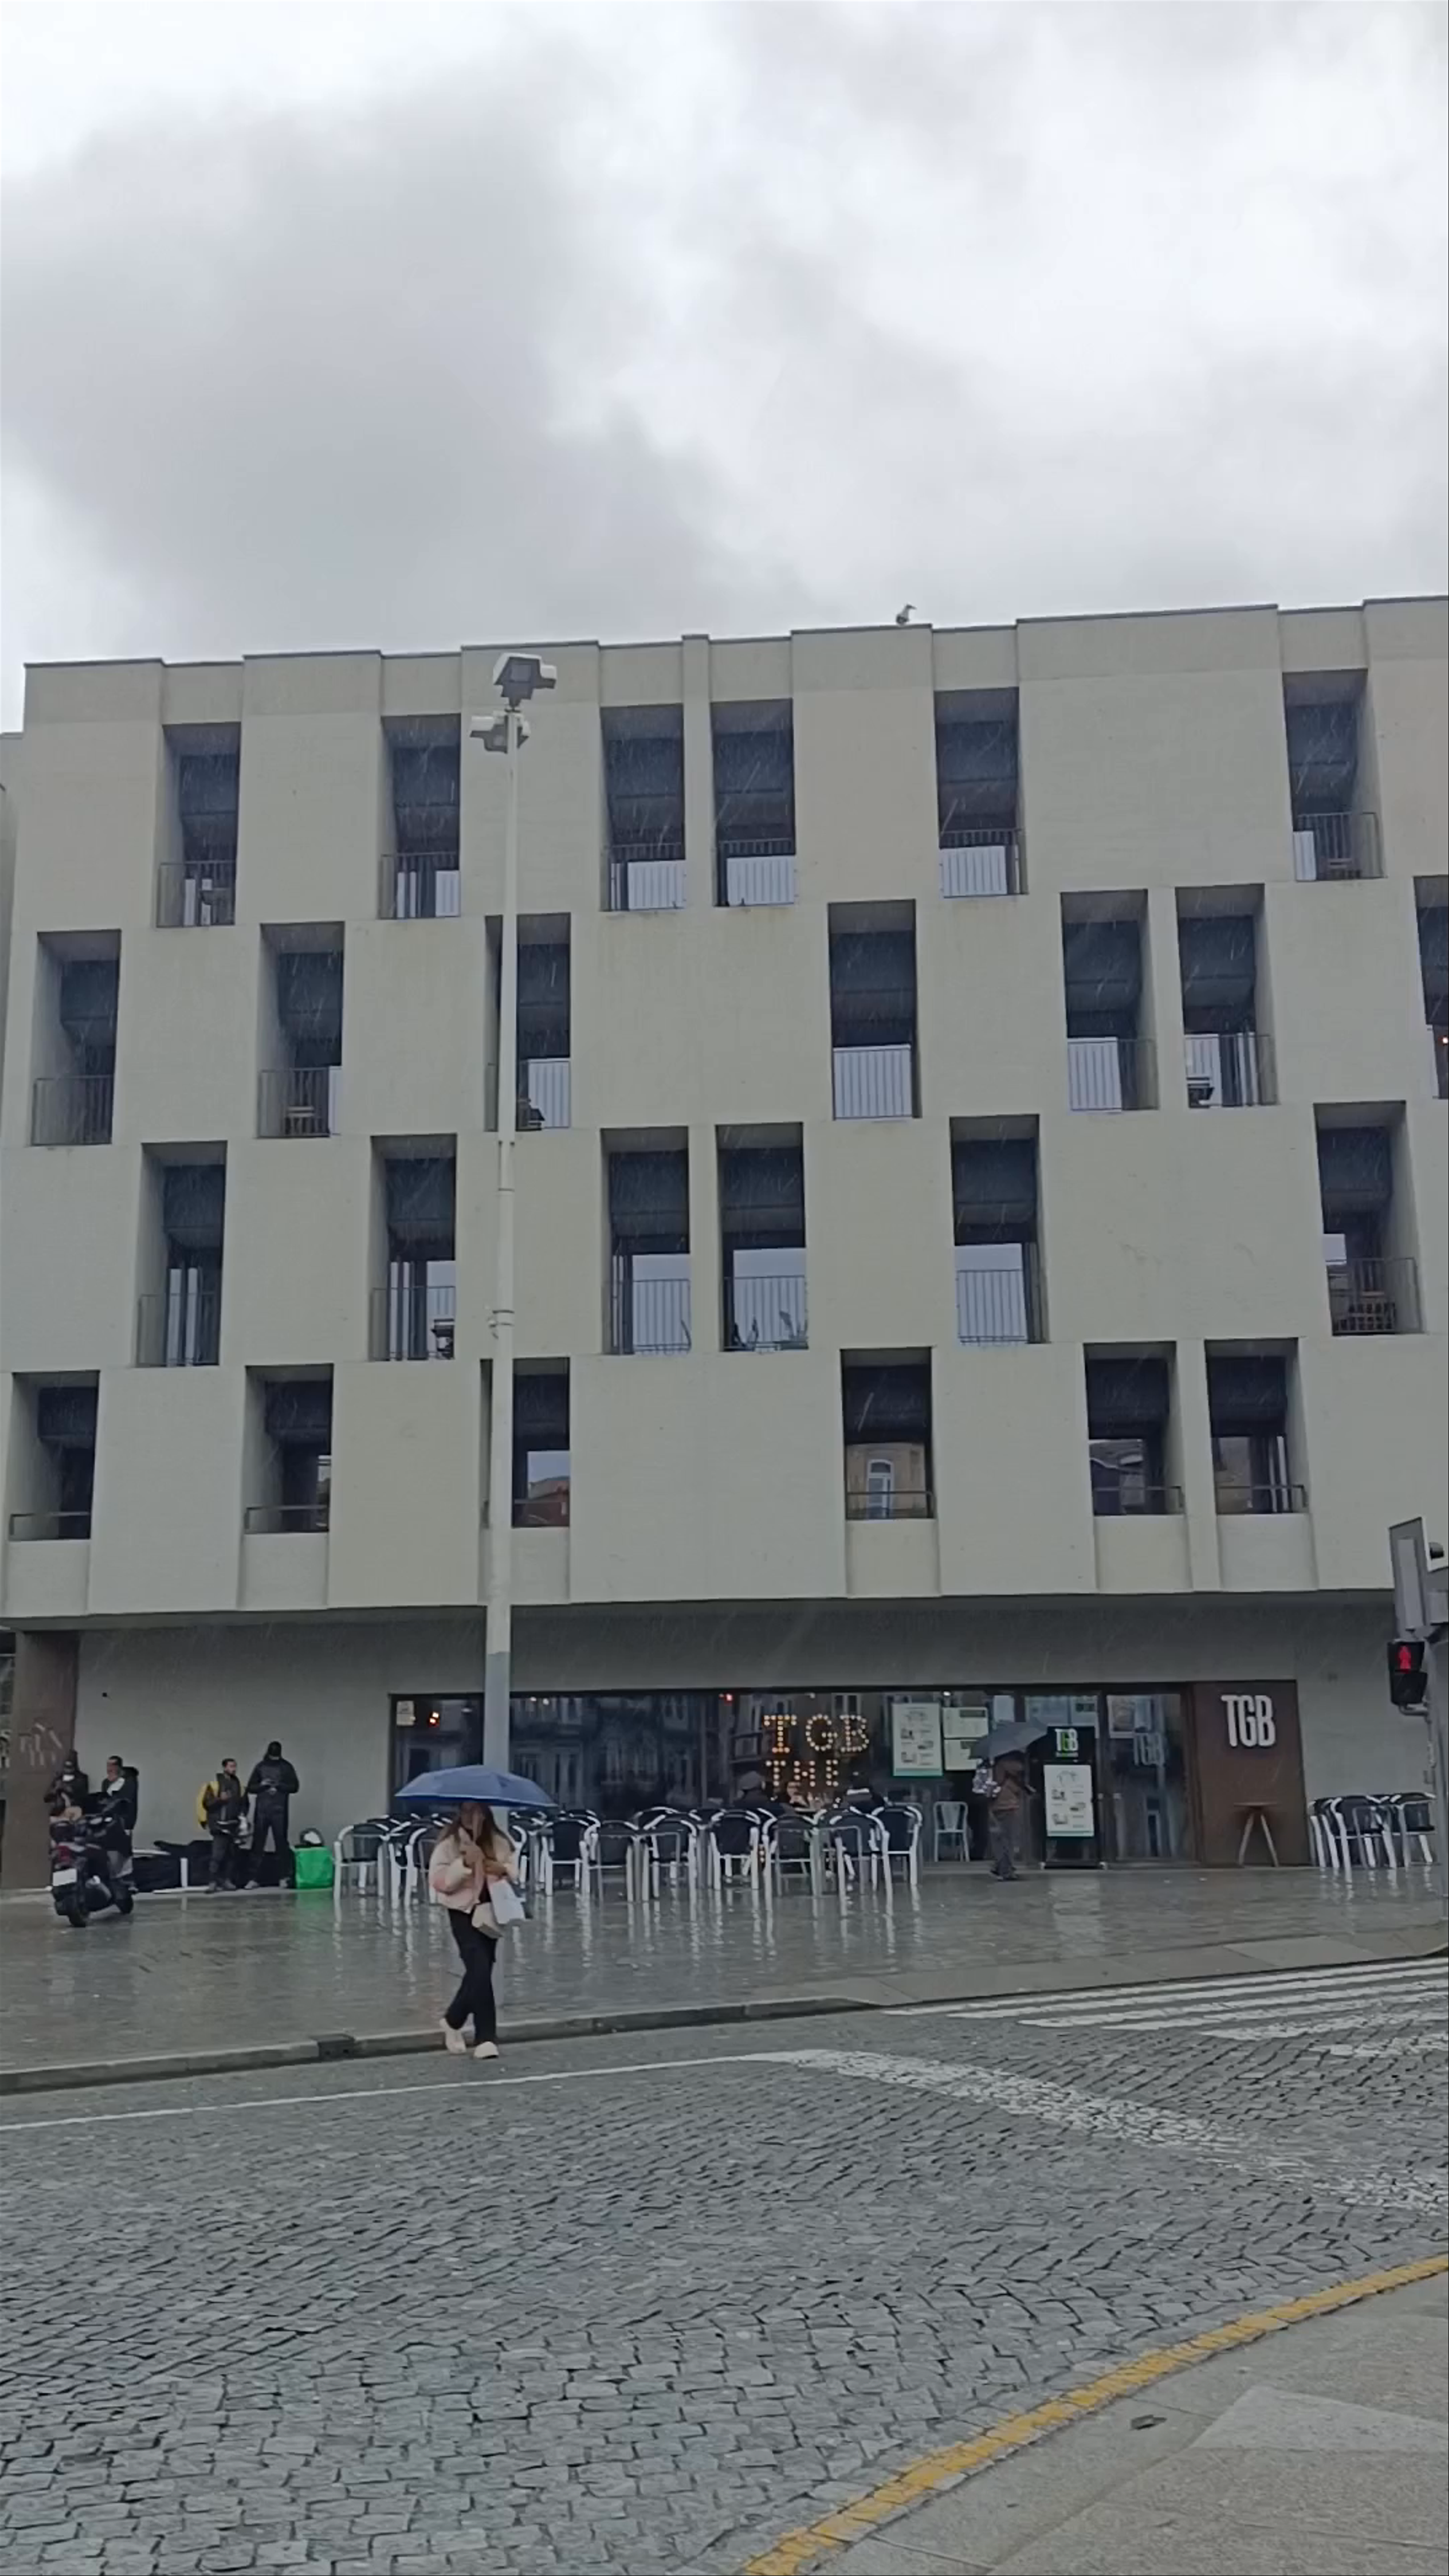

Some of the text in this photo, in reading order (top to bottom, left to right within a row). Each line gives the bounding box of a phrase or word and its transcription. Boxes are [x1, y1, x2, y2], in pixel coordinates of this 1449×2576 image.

[763, 1713, 869, 1753] TGB
[1055, 1728, 1079, 1751] TGB
[1220, 1694, 1277, 1748] TGB
